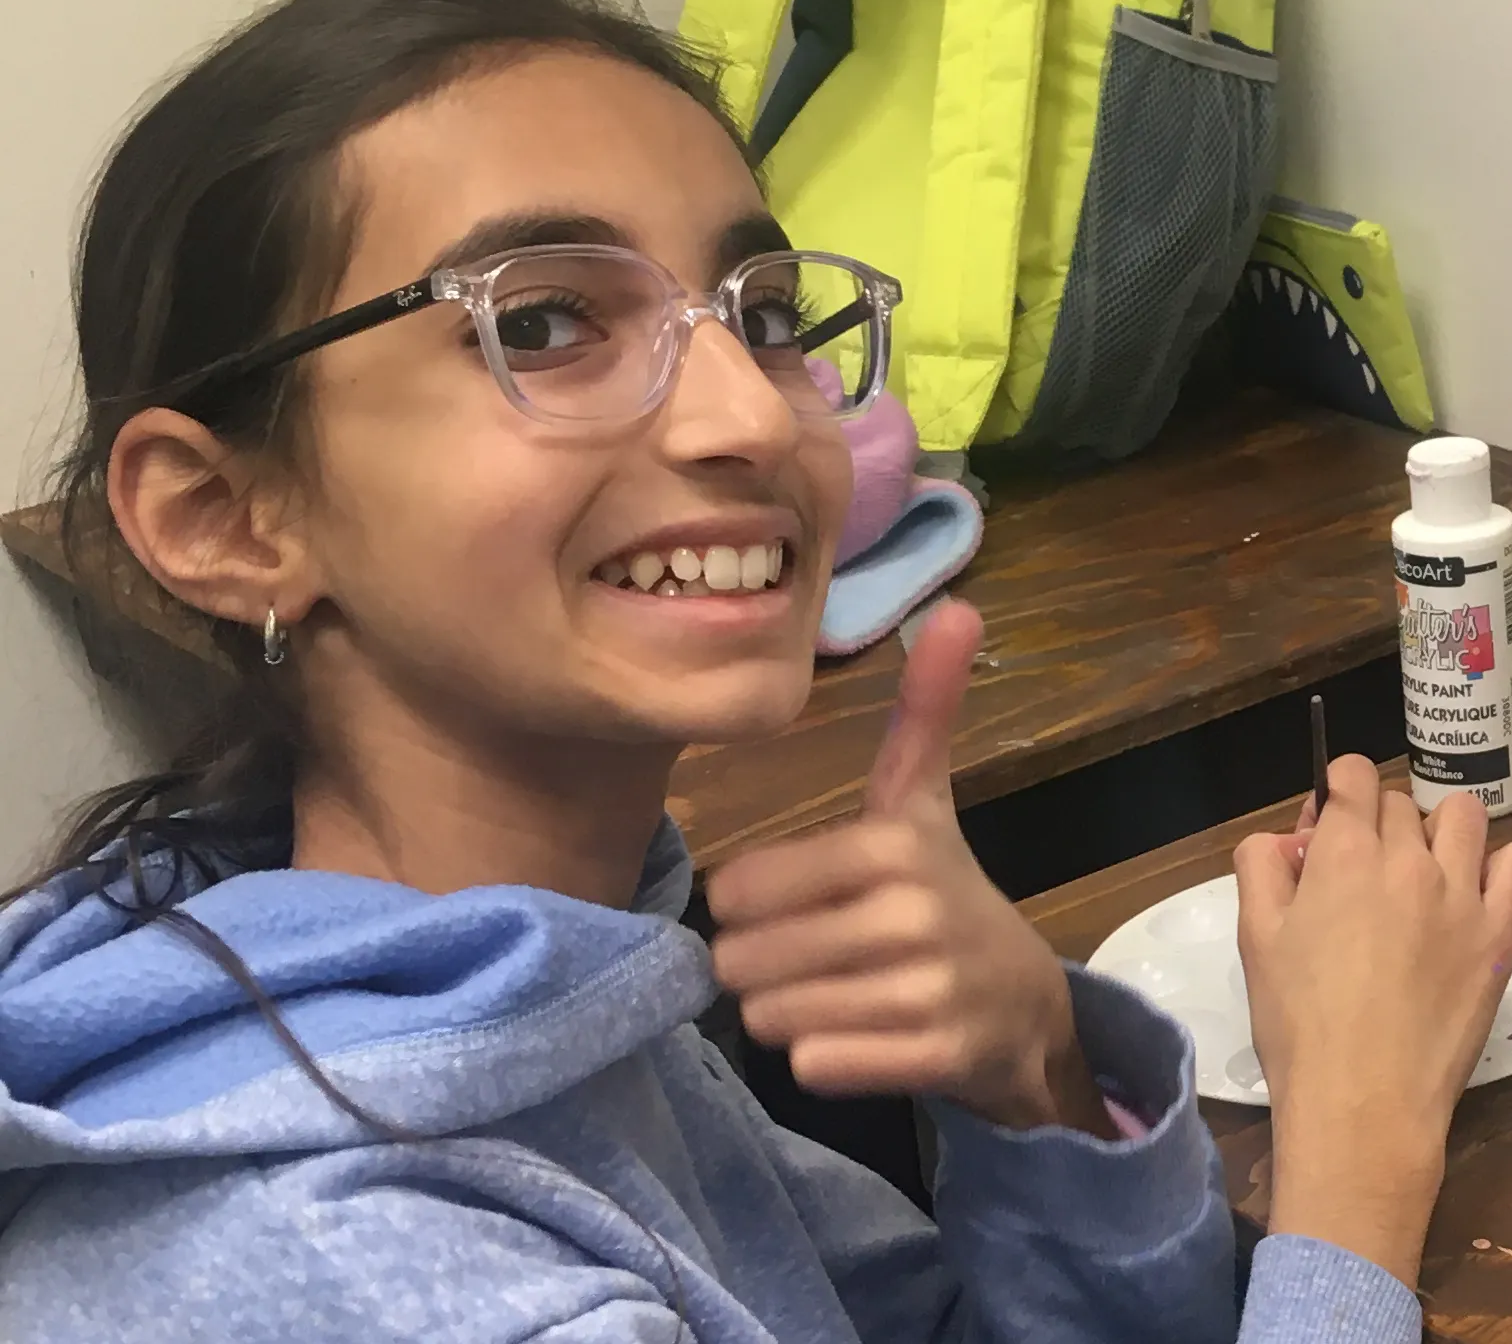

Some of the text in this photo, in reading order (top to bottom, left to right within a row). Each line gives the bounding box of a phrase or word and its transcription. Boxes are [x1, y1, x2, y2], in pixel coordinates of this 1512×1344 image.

[1432, 684, 1473, 698] PAINT
[1423, 704, 1498, 724] ACRYLIQUE
[1428, 730, 1490, 746] ACRÍLICA
[1422, 753, 1447, 768] White
[1467, 783, 1505, 807] 18ml
